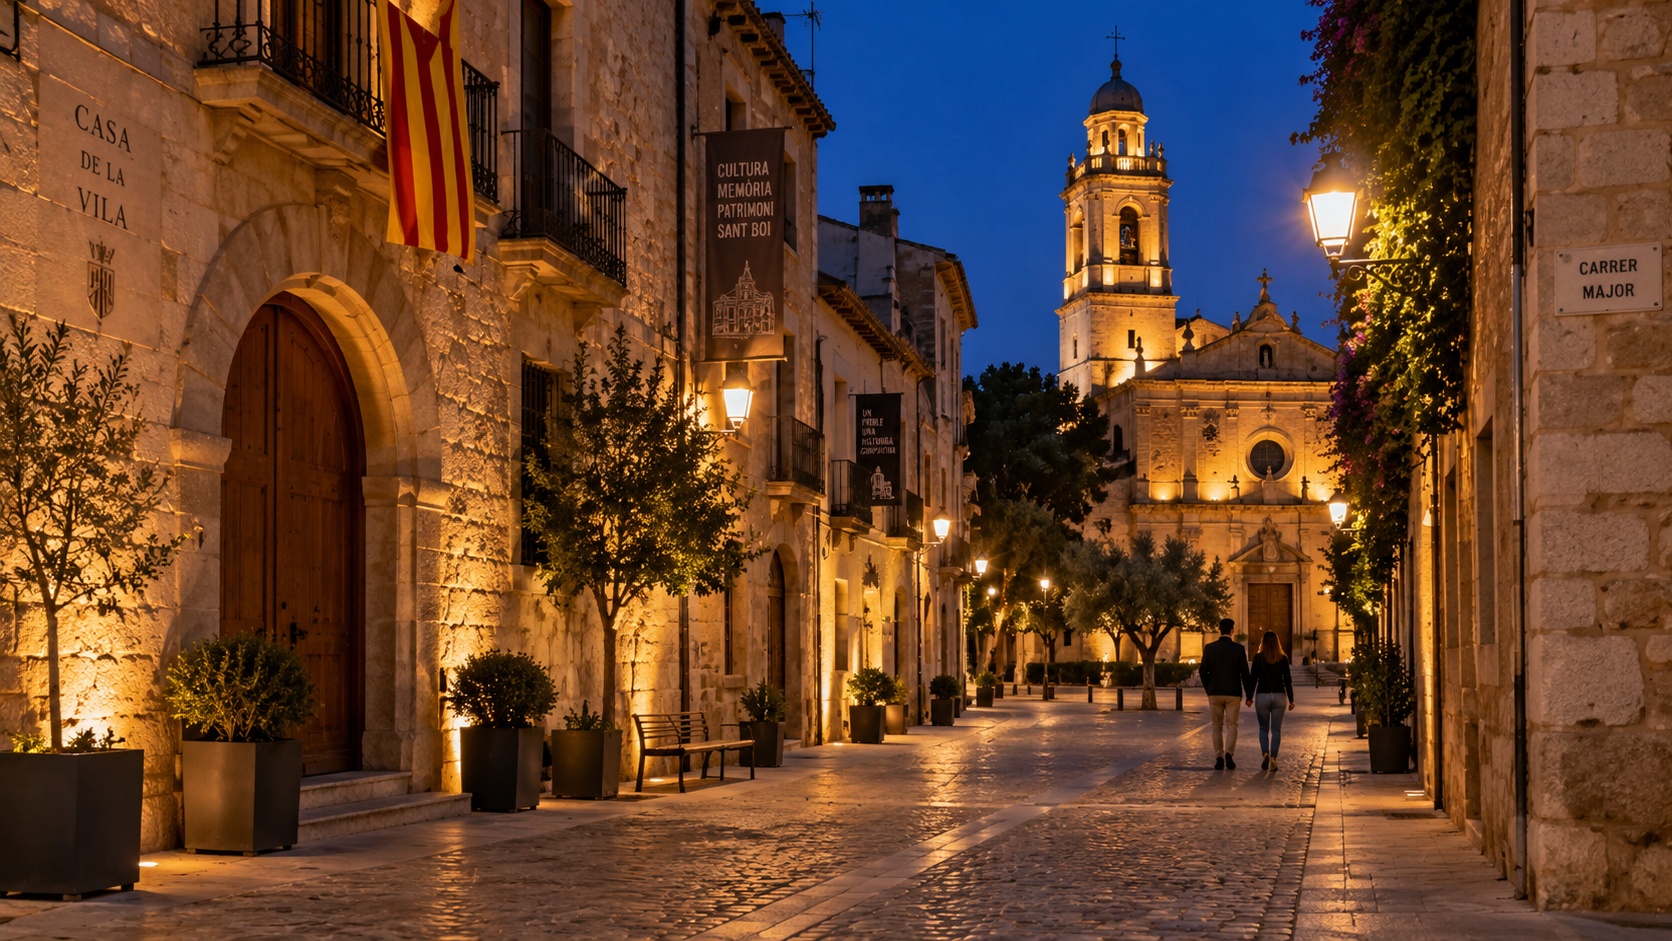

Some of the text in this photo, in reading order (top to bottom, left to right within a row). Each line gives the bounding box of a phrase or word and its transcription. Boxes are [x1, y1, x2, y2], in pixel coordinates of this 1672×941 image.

[75, 104, 131, 153] CASA
[81, 149, 125, 187] DE LA
[718, 161, 769, 178] CULTURA
[77, 186, 128, 230] VILA
[718, 201, 774, 218] PATRIMONI
[718, 221, 771, 238] SANT BOI
[1579, 259, 1638, 275] CARRER
[1583, 283, 1635, 299] MAJOR
